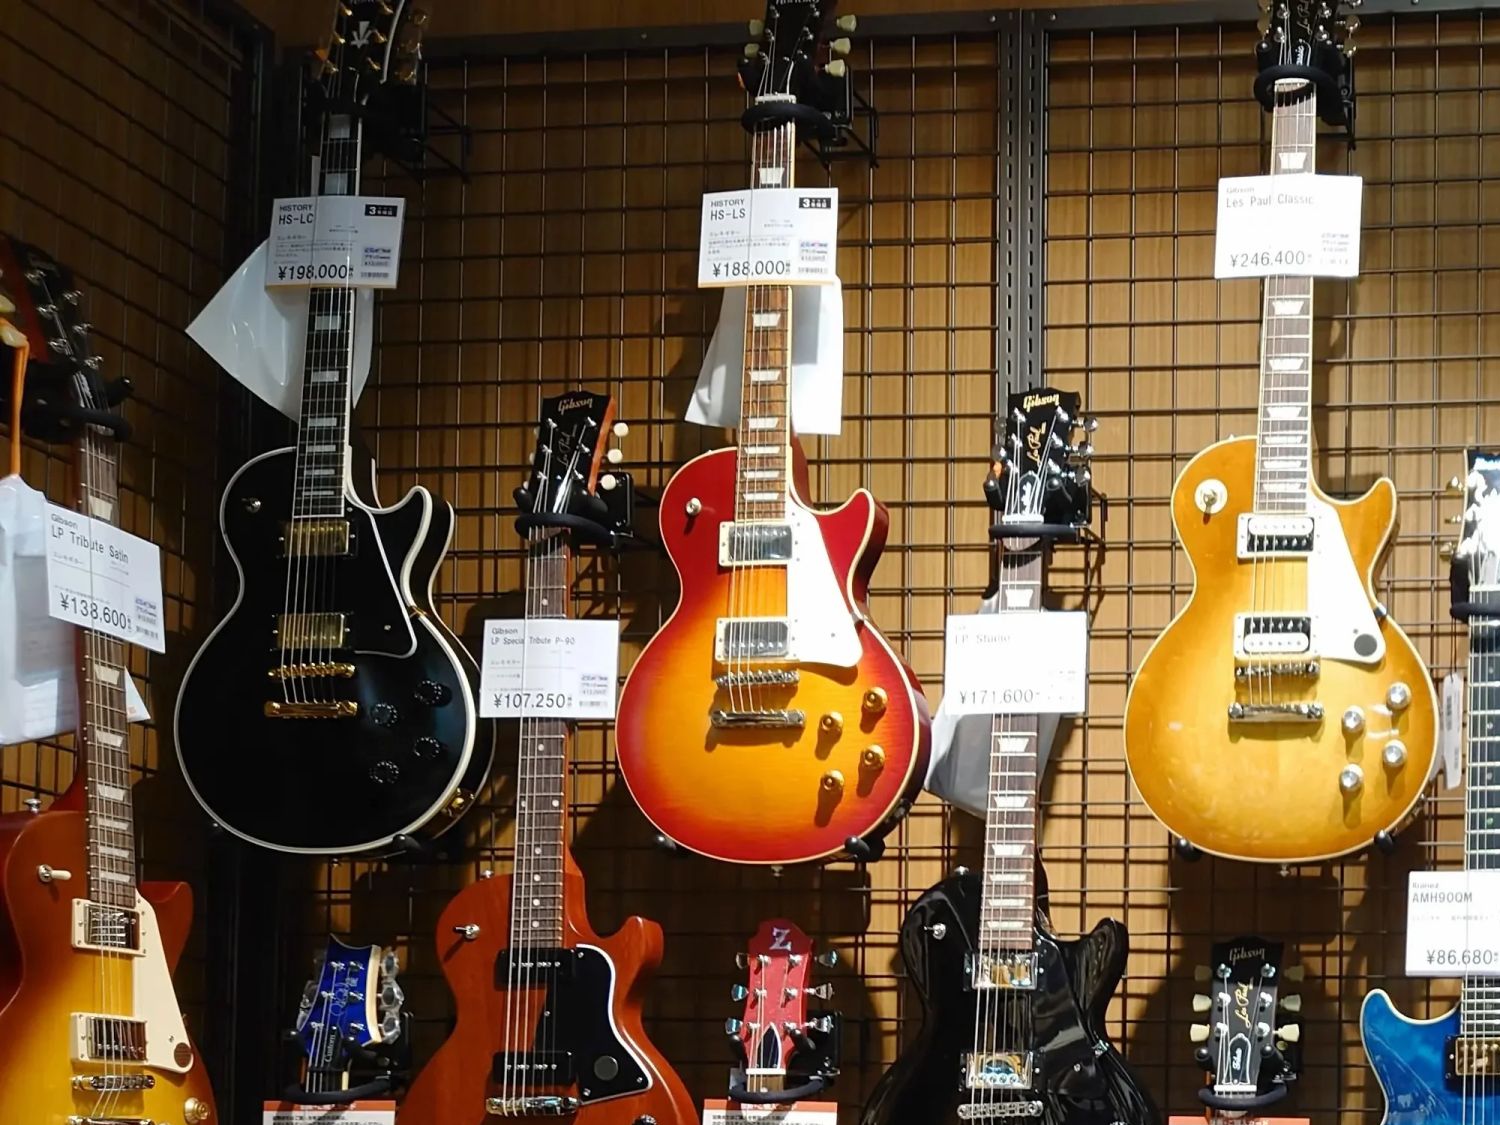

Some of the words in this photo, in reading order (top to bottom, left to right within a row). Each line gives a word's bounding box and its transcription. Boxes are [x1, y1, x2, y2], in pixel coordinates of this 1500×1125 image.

[279, 203, 313, 212] HISTORY
[710, 199, 745, 207] HISTORY
[1226, 197, 1244, 208] Les
[1250, 195, 1272, 207] Paul
[1277, 193, 1315, 205] Classic
[278, 213, 315, 225] HS-LC
[709, 208, 746, 221] HS-LS
[1229, 249, 1306, 268] ¥246,400
[278, 264, 348, 281] ¥198,000
[711, 260, 786, 278] ¥188,000
[557, 397, 593, 416] Gibson
[1022, 393, 1061, 413] Gibson
[50, 513, 78, 529] Gibson
[51, 525, 67, 540] LP
[71, 530, 105, 555] Tribute
[108, 544, 129, 565] Satin
[60, 591, 128, 630] ¥138,600
[491, 626, 518, 635] Gibson
[491, 636, 500, 645] LP
[503, 636, 526, 646] Specia
[528, 635, 552, 645] Tribute
[554, 636, 575, 646] P-90
[493, 692, 565, 709] ¥107,250
[1228, 947, 1265, 966] Gibson
[1426, 949, 1493, 967] ¥86,680
